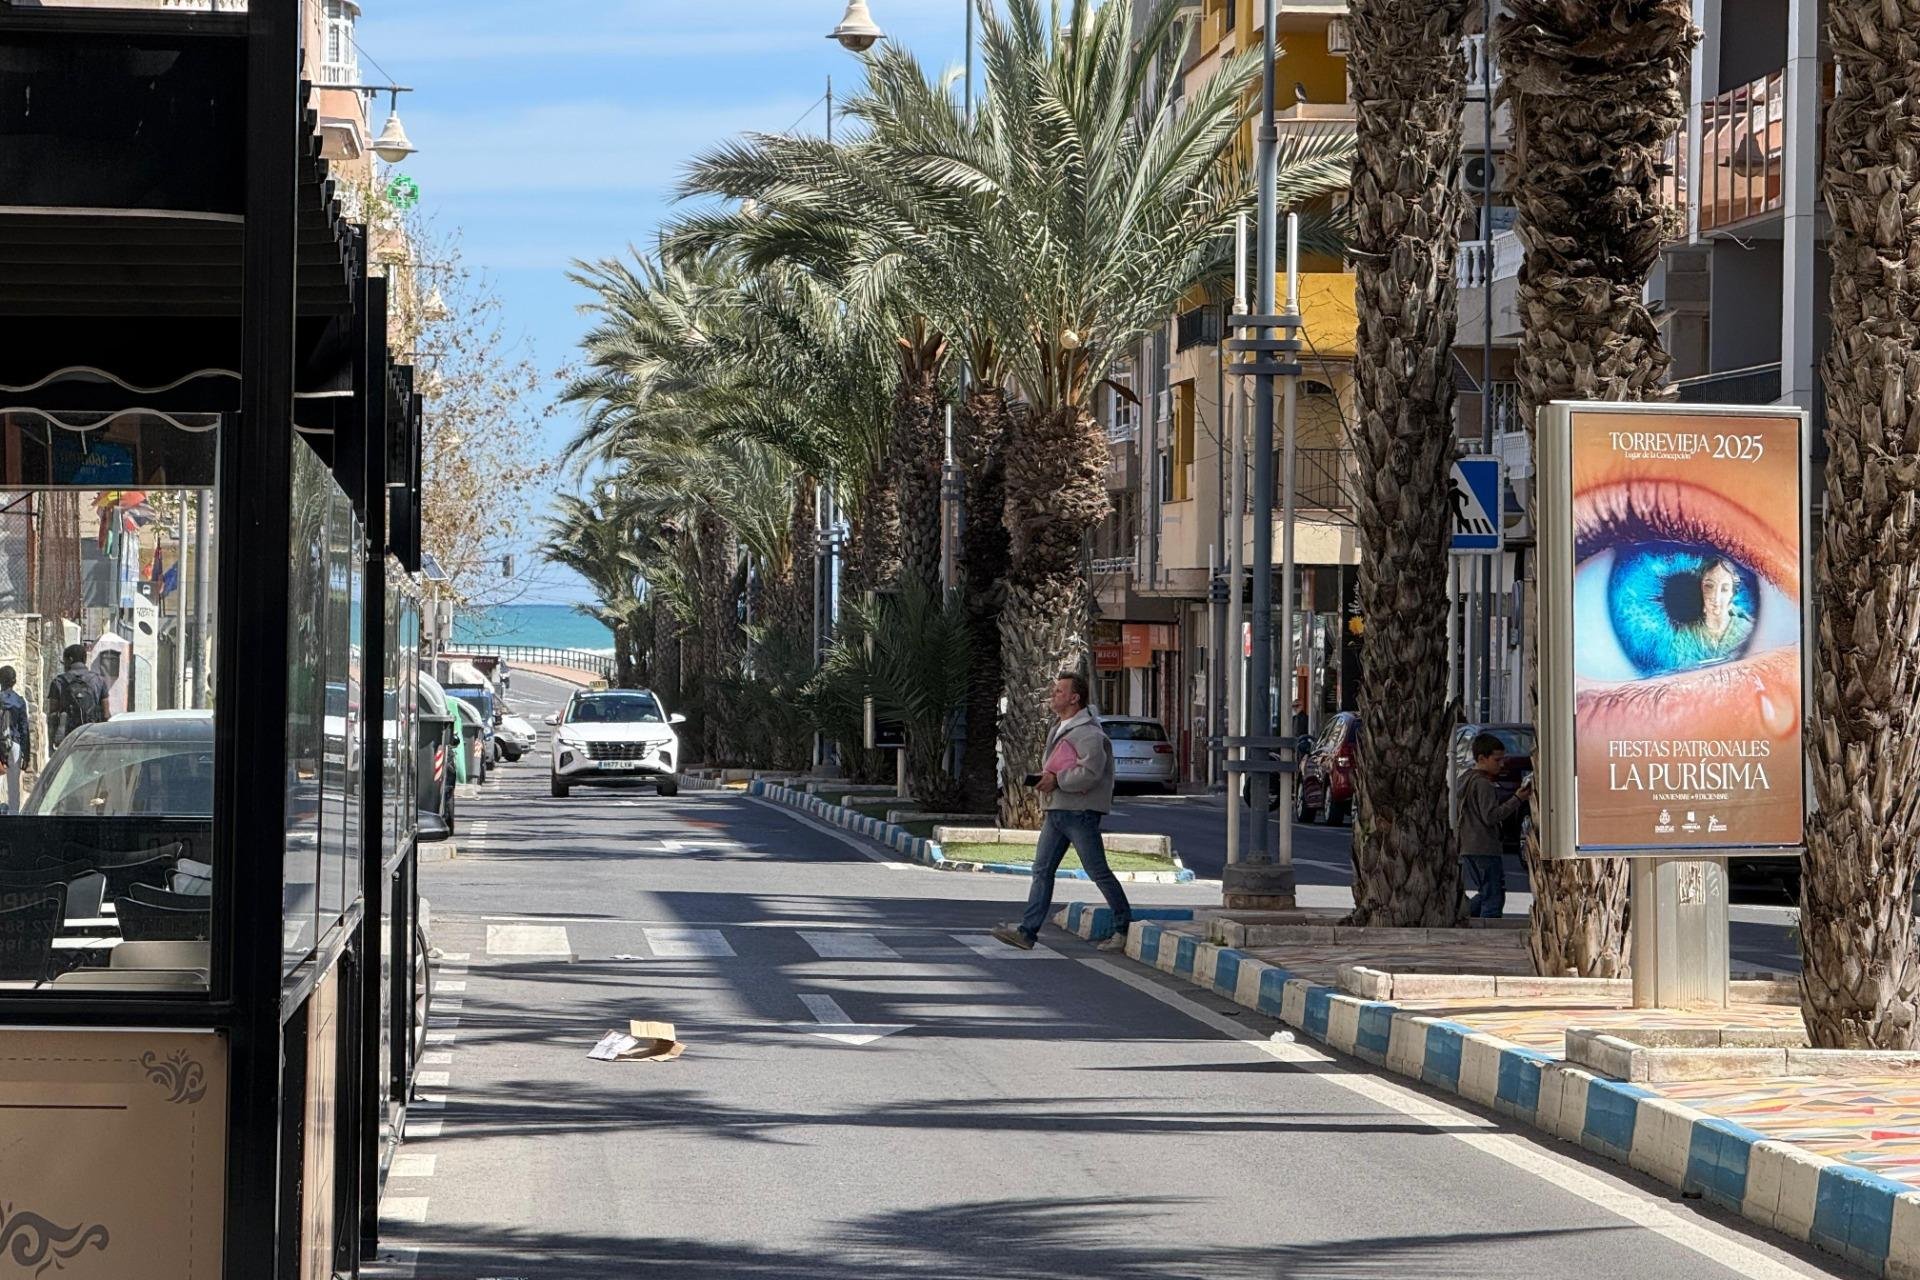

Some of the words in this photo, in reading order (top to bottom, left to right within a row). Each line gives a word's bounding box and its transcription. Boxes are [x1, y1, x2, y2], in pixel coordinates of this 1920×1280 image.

[1608, 431, 1710, 454] TORREVIEJA
[1712, 433, 1765, 463] 2025
[1624, 451, 1641, 460] Lugar
[1642, 451, 1649, 459] de
[1609, 740, 1670, 758] FIESTAS
[1673, 740, 1770, 757] PATRONALES
[1609, 763, 1644, 790] LA
[1648, 758, 1770, 790] PURÍSIMA
[1659, 793, 1690, 801] NOVIEMBRE
[1699, 793, 1730, 801] DICIEMBRE
